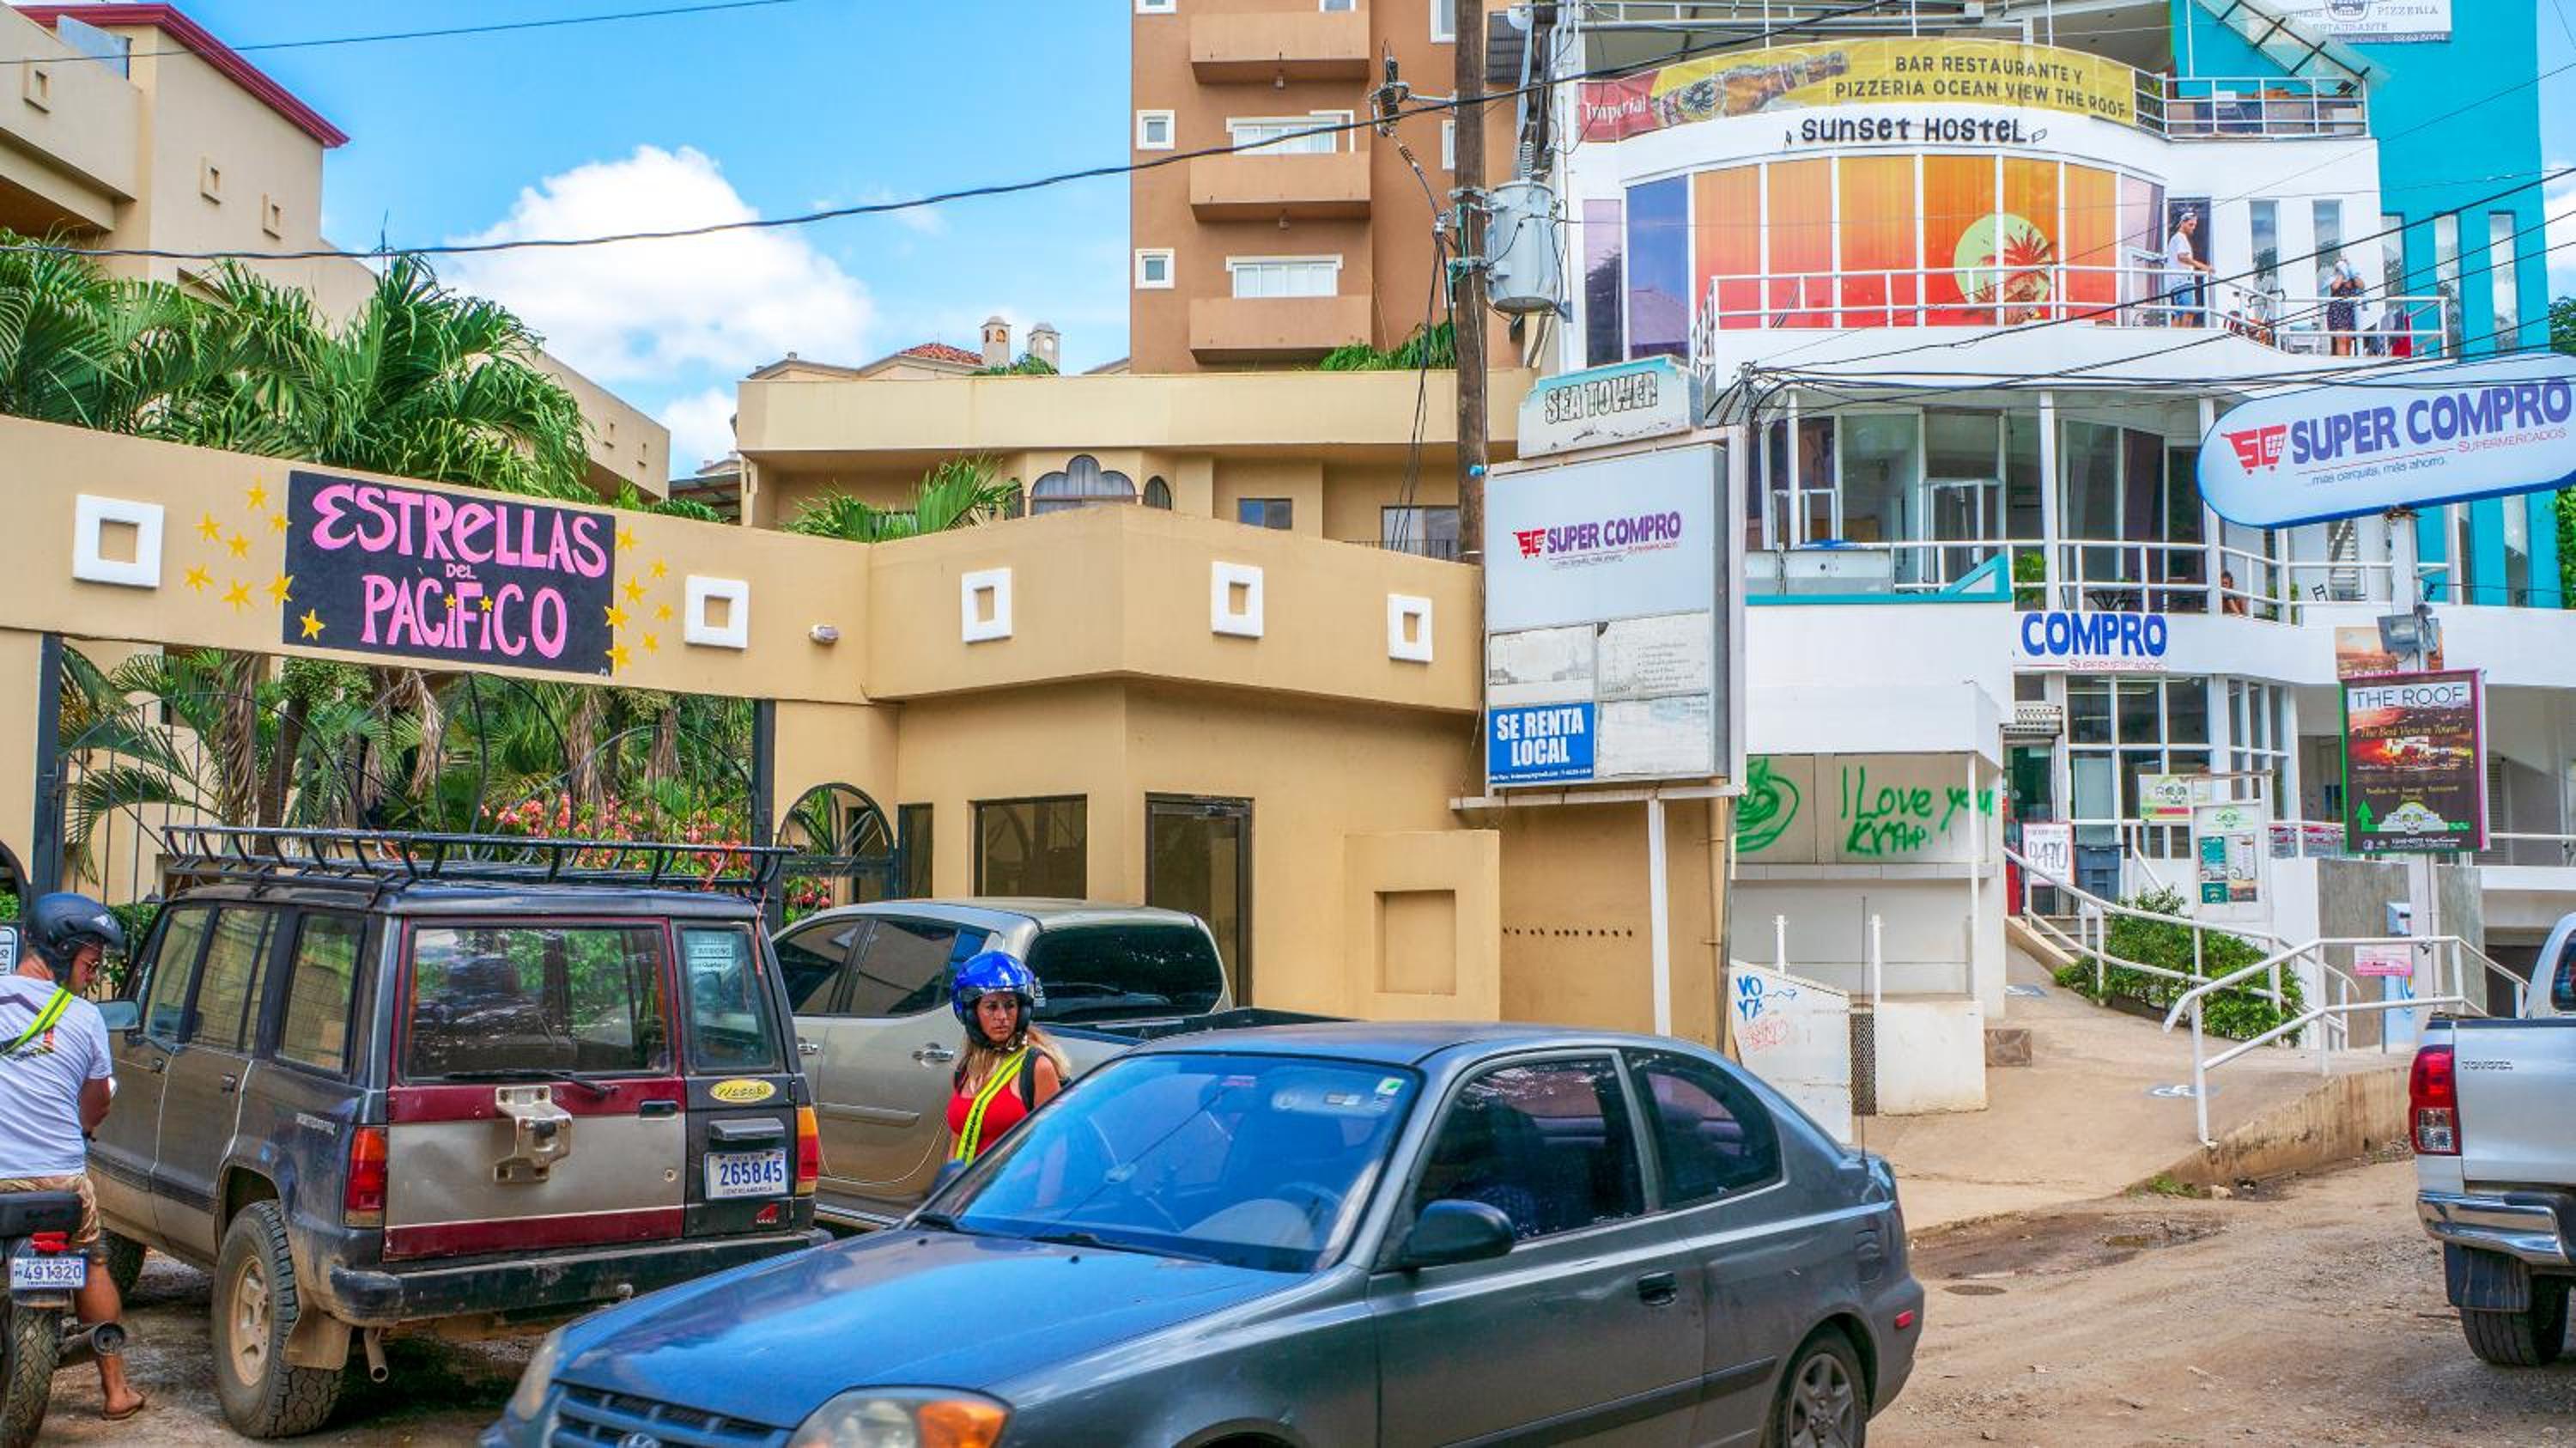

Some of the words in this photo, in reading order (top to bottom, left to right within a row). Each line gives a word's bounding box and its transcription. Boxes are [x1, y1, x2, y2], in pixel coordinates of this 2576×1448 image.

[1895, 56, 1934, 72] BAR
[1941, 56, 2068, 83] RESTAURANTE
[2072, 70, 2083, 85] Y
[1585, 96, 1646, 125] Imperial
[1835, 81, 1925, 98] PIZZERIA
[1933, 81, 1998, 97] OCEAN
[2005, 83, 2048, 100] VIEW
[2055, 88, 2085, 106] THE
[2089, 97, 2126, 118] ROOF
[1545, 385, 1583, 424] SEA
[1585, 371, 1658, 417] TOWER
[2292, 406, 2399, 465] SUPER
[2406, 378, 2572, 445] COMPRO
[1547, 522, 1600, 554] SUPER
[1604, 511, 1681, 546] COMPRO
[2021, 612, 2167, 658] COMPRO
[2354, 691, 2395, 708] THE
[2403, 686, 2464, 707] ROOF
[1497, 714, 1521, 741] SE
[1524, 708, 1584, 738] RENTA
[1511, 736, 1571, 767] LOCAL
[720, 1161, 783, 1186] 265845
[24, 1265, 82, 1280] 491320
